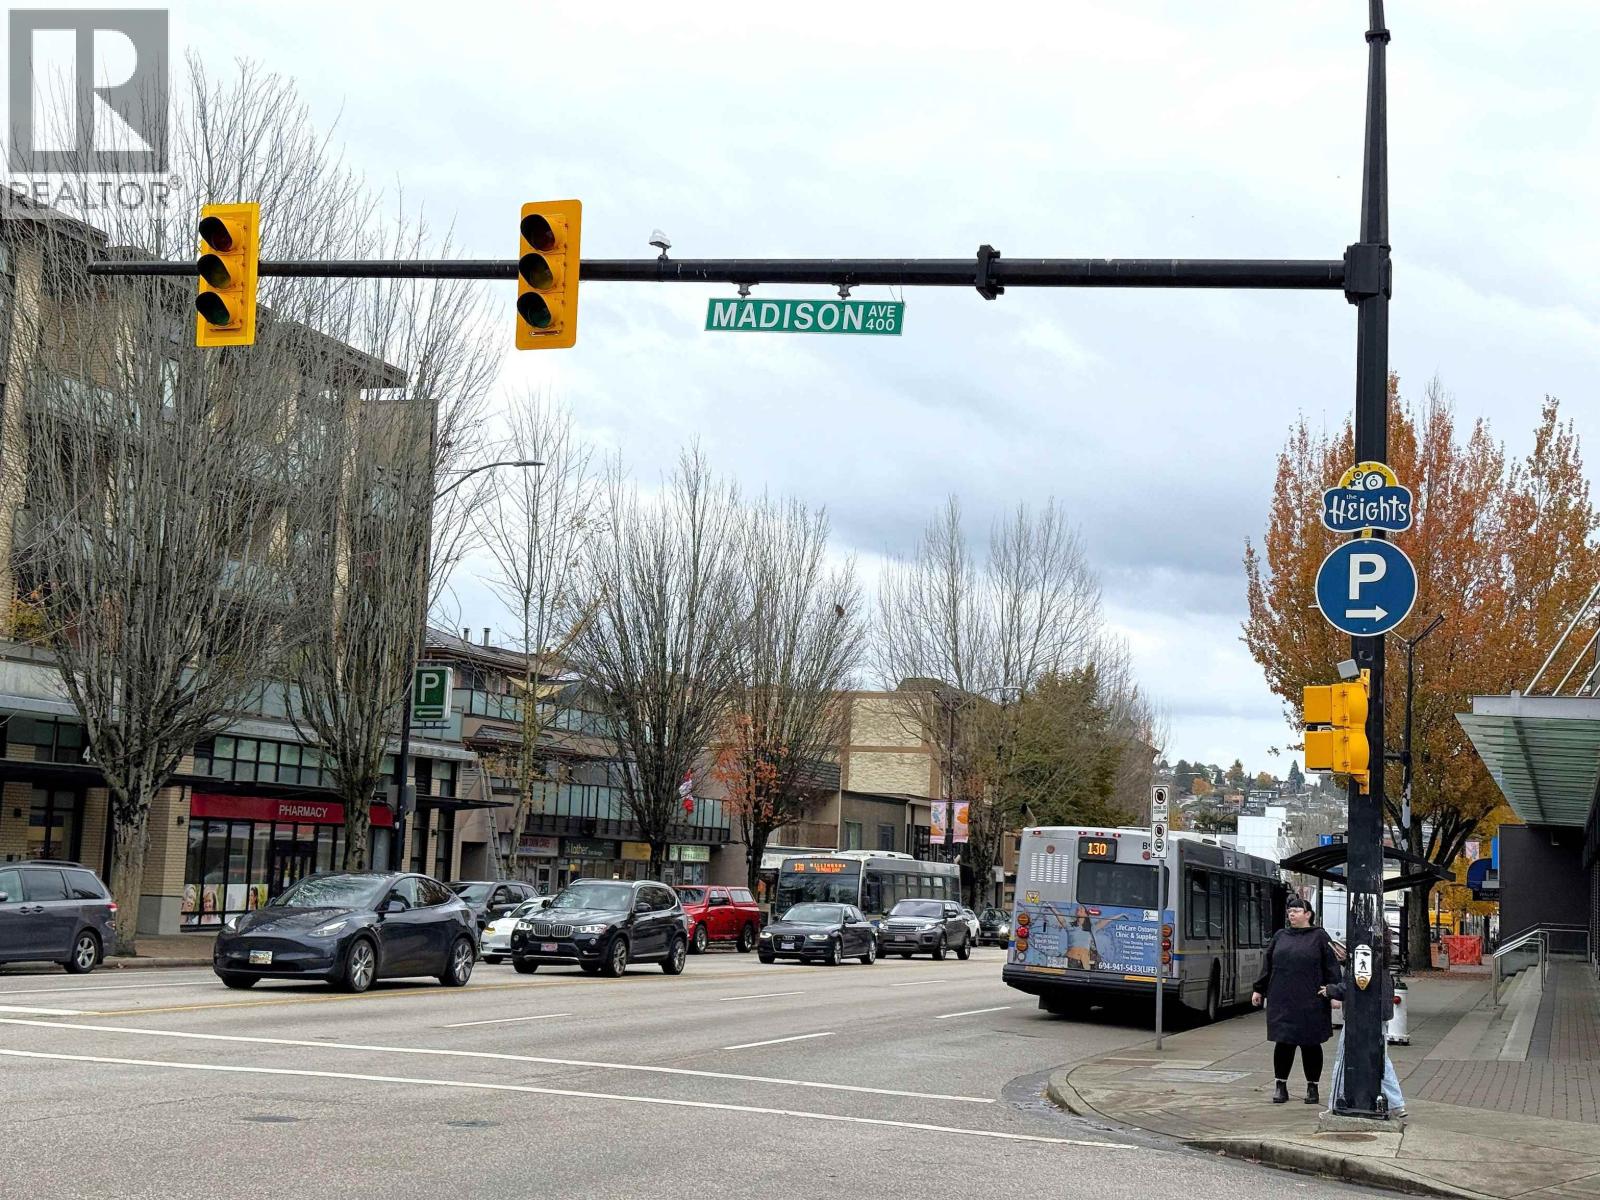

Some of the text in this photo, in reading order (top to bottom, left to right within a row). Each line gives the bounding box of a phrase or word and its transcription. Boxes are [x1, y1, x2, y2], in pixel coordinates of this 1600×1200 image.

[712, 302, 864, 331] MADISON
[868, 305, 896, 318] AVE
[866, 319, 895, 331] 400
[1349, 553, 1387, 600] P
[420, 672, 440, 703] P
[279, 804, 328, 818] PHARMACY
[1087, 842, 1107, 856] 130
[1115, 924, 1137, 932] LifeCare
[1136, 932, 1158, 941] Supplies
